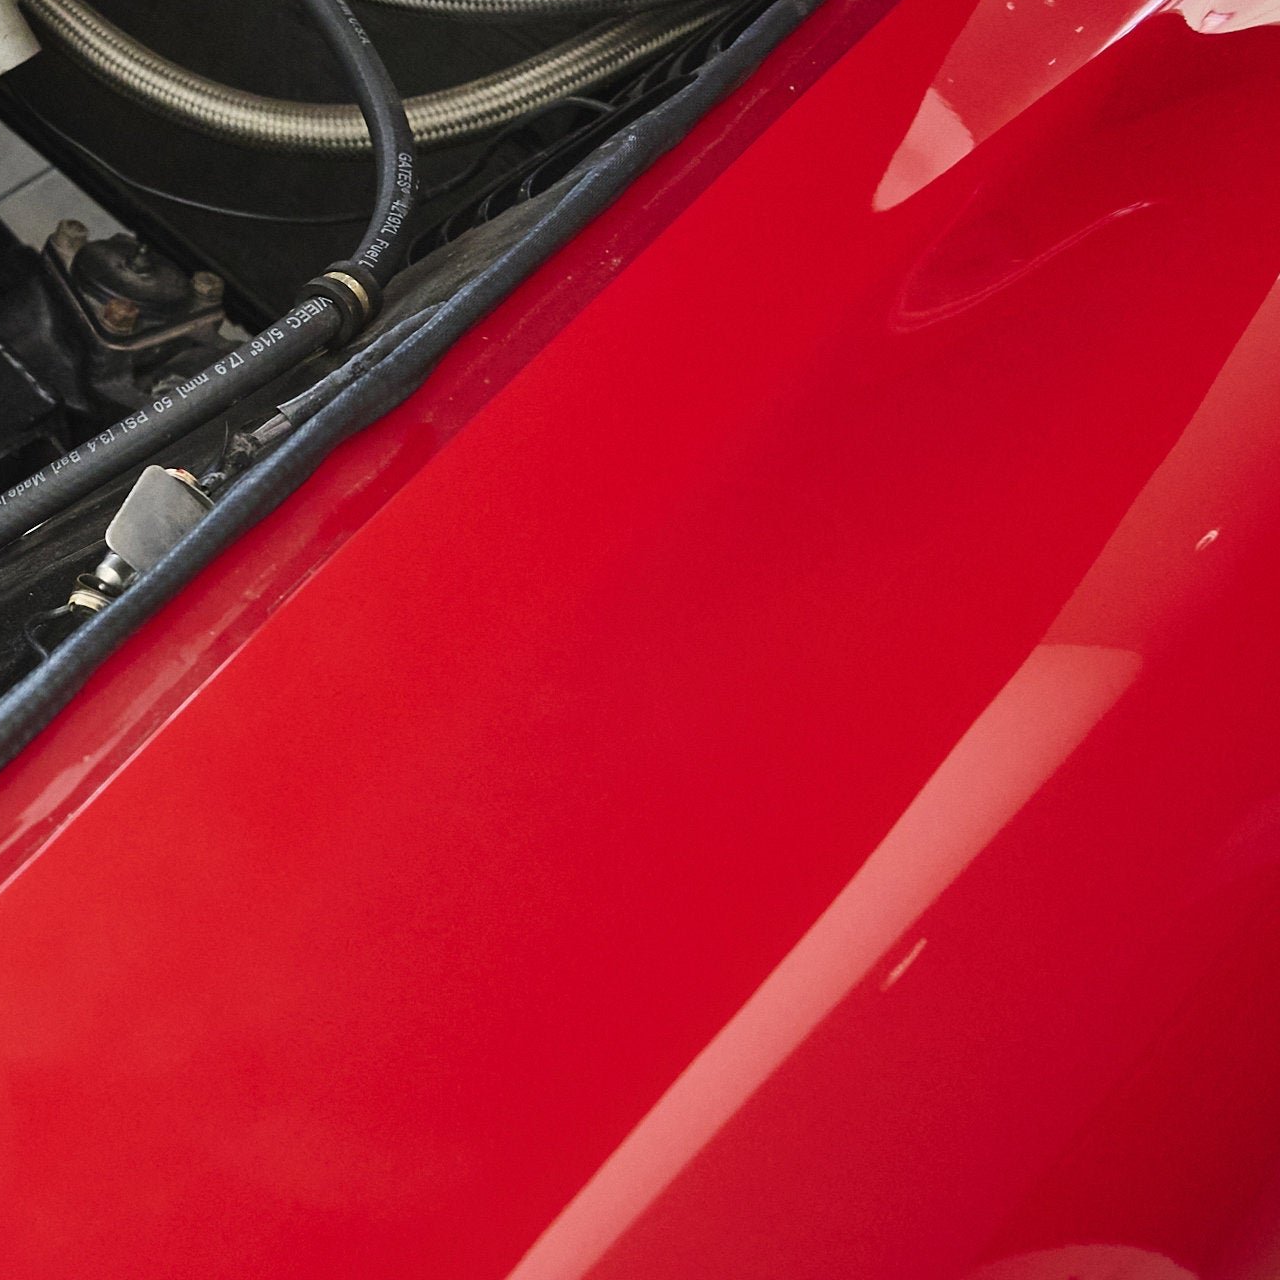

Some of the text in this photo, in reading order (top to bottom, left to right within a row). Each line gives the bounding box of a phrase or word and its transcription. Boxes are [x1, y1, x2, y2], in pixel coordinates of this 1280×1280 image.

[363, 236, 390, 264] Fuel
[153, 396, 174, 414] 50
[120, 410, 149, 434] PSI
[7, 472, 47, 500] Made
